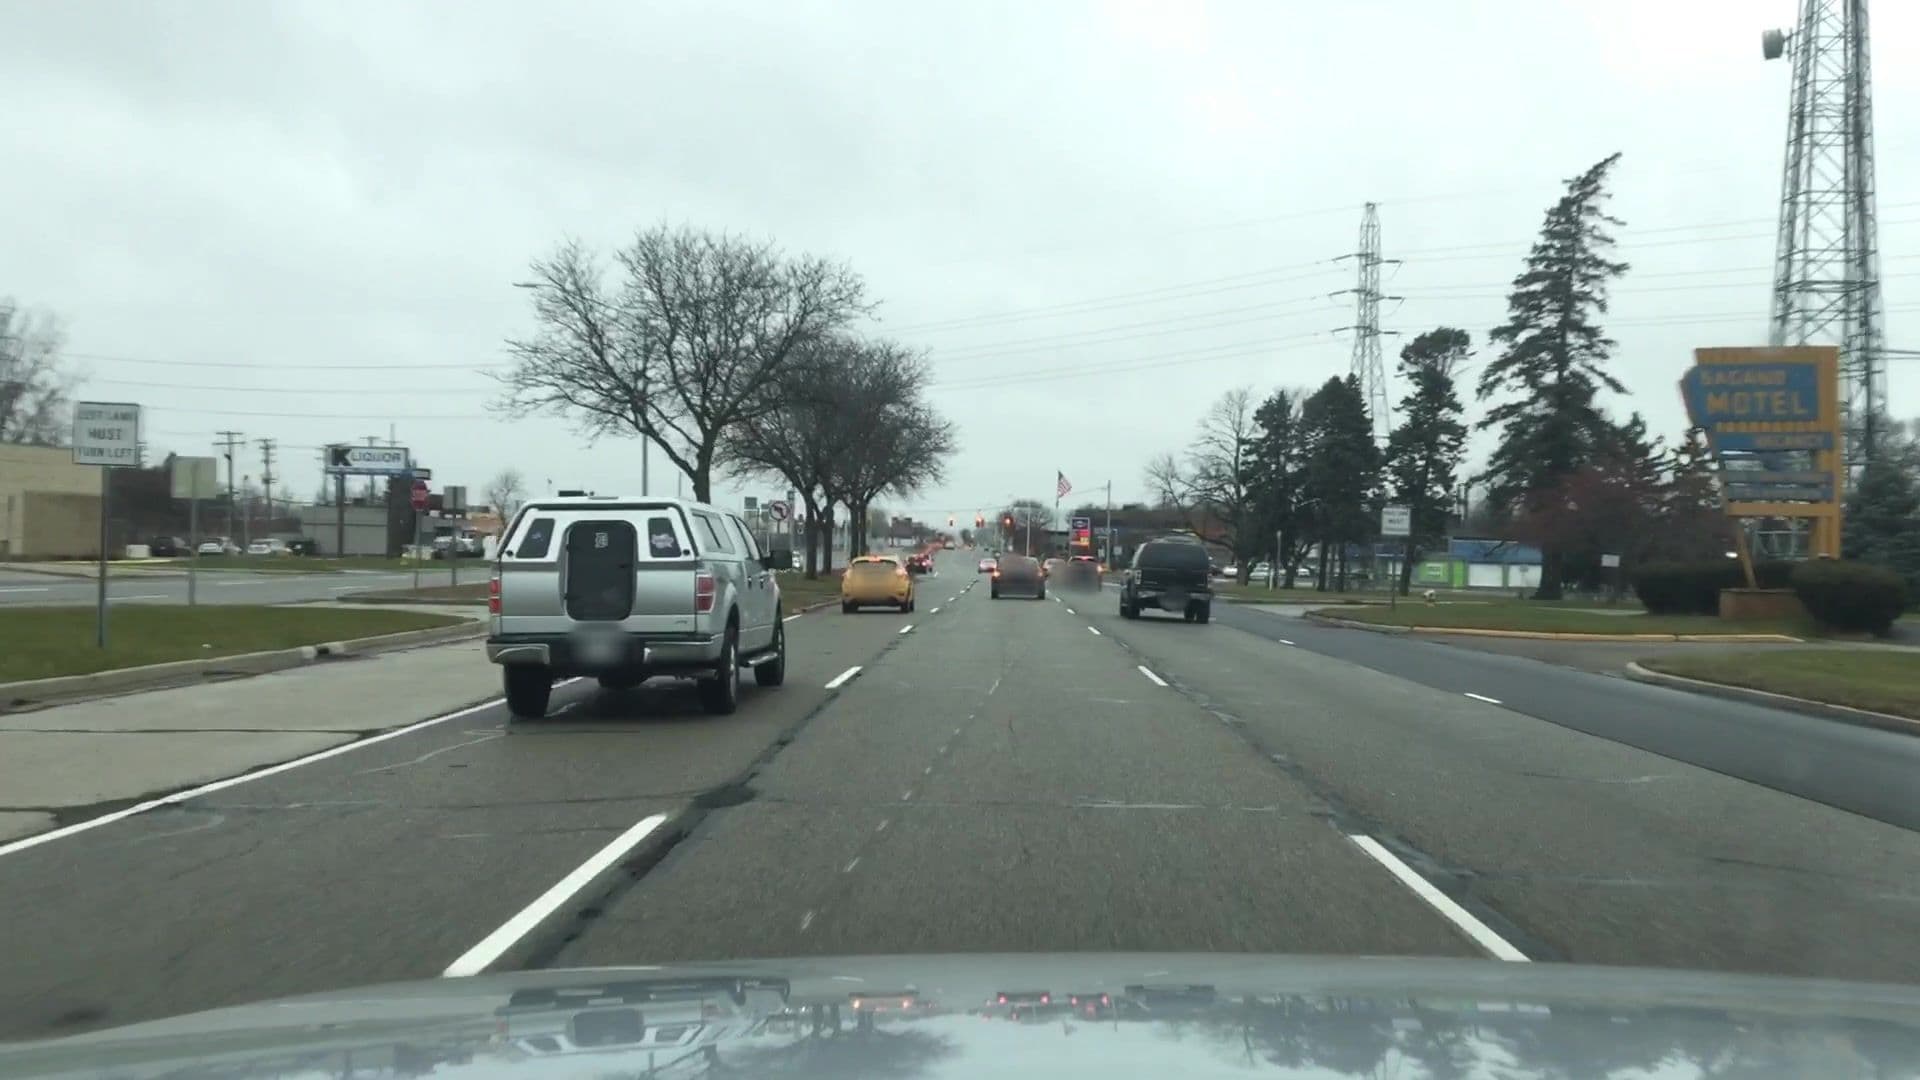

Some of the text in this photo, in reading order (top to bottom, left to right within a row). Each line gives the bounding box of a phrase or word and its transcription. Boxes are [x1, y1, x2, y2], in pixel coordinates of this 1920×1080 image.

[1707, 391, 1809, 414] MOTEL
[88, 427, 122, 440] MUST
[351, 452, 401, 463] LIQUOR
